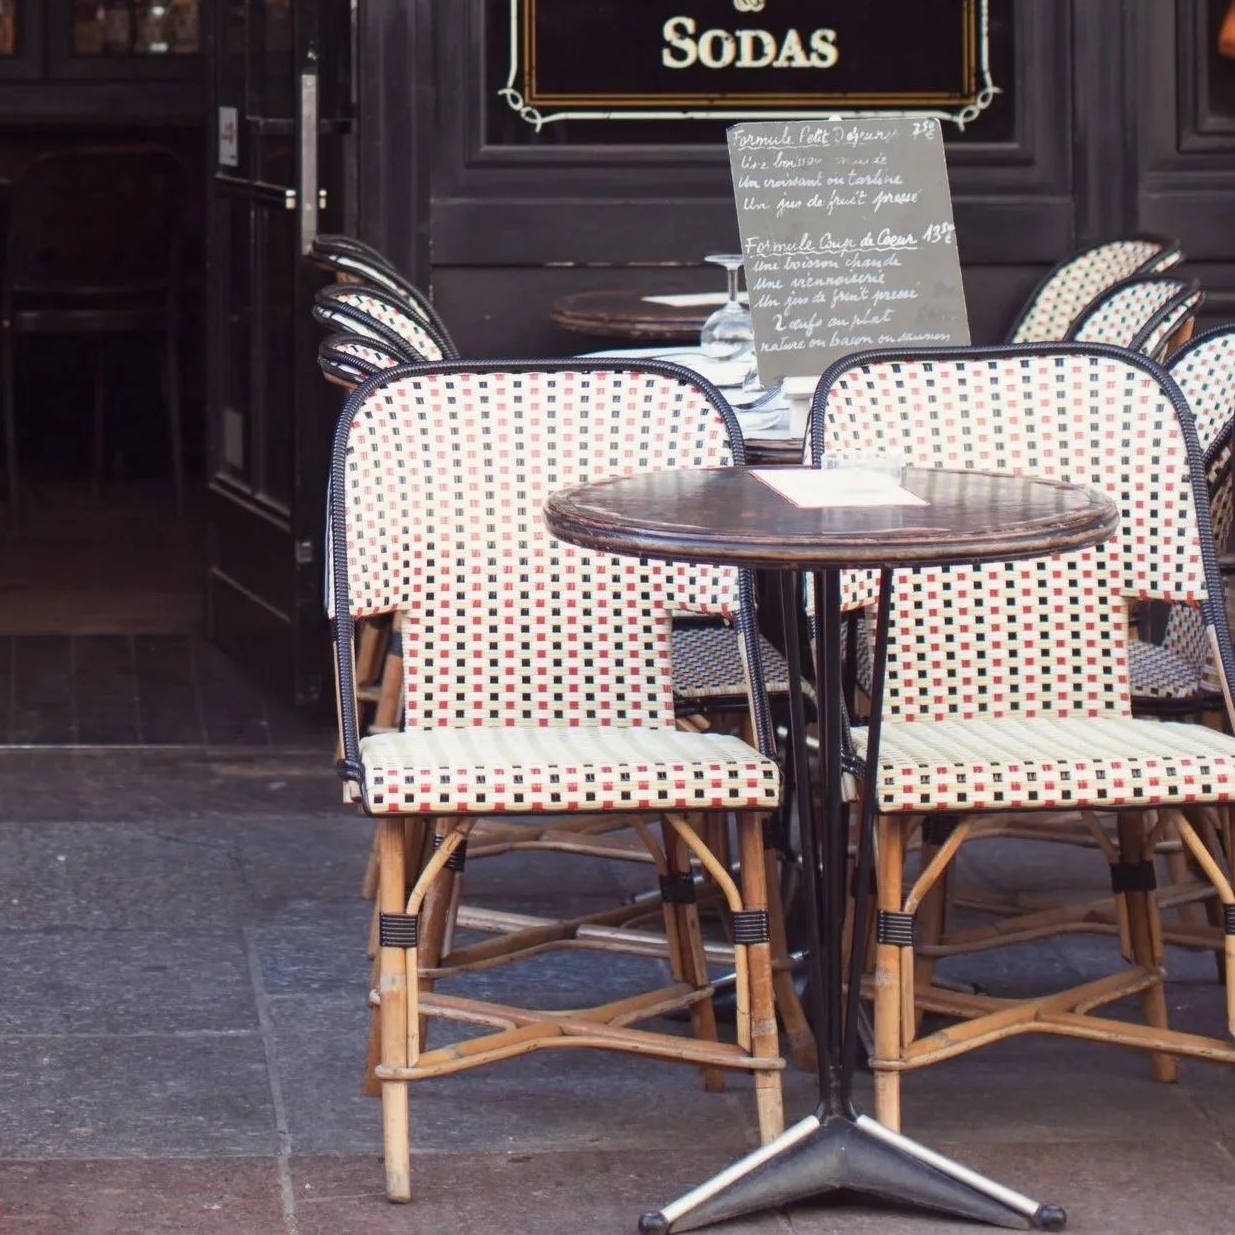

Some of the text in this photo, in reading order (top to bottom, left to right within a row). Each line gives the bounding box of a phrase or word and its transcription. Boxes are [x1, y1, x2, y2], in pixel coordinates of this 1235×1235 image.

[661, 16, 839, 69] SODAS
[733, 126, 792, 147] Formule
[799, 125, 830, 144] Petit
[738, 175, 761, 189] Un
[764, 170, 824, 189] croissant
[848, 168, 904, 186] tartine
[744, 188, 923, 219] Un jus de fruit pressé
[745, 232, 816, 254] Formule
[819, 232, 857, 258] Coup
[860, 231, 875, 247] de
[784, 256, 840, 270] boisson
[845, 252, 902, 268] chaude
[752, 268, 886, 291] Une viennoiserie
[753, 294, 781, 308] Un
[783, 289, 809, 318] jus
[812, 290, 826, 303] de
[829, 286, 869, 310] fruit
[772, 313, 787, 332] 2
[827, 316, 850, 328] au
[848, 307, 897, 332] plat
[760, 335, 806, 353] nature
[808, 337, 826, 349] ou
[828, 331, 873, 347] bacon
[878, 333, 896, 344] ou
